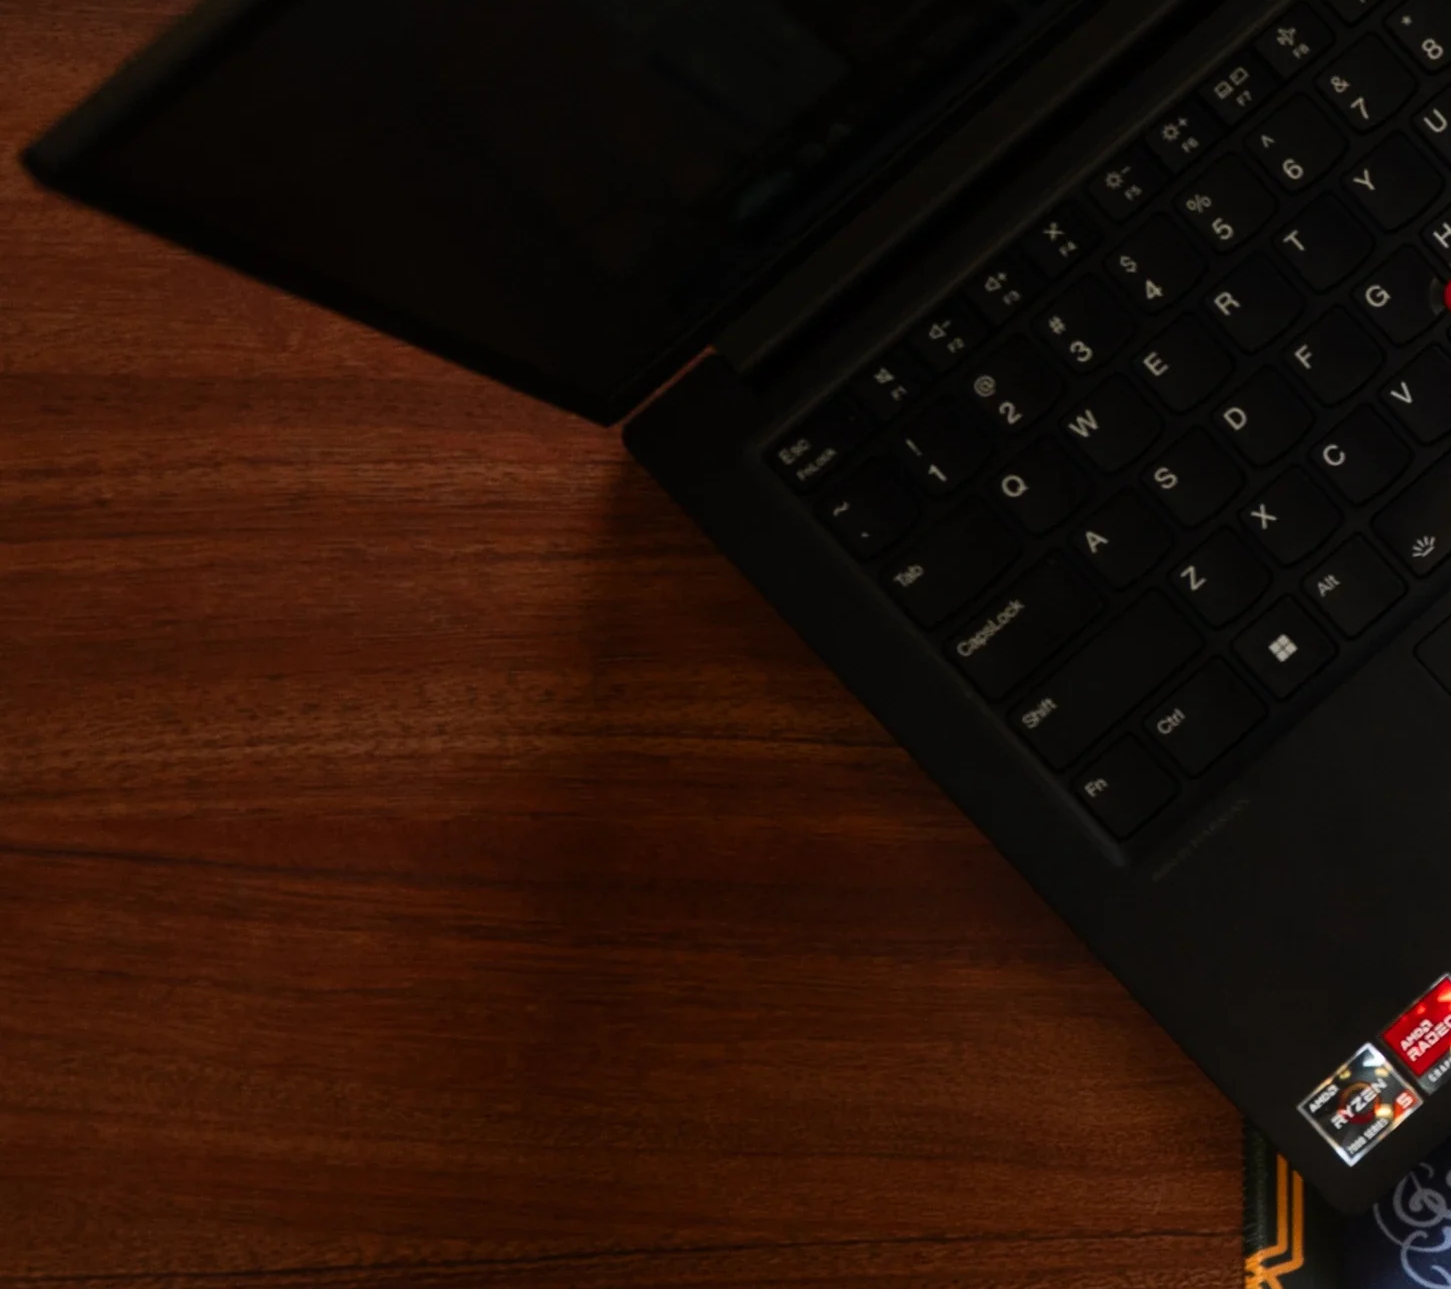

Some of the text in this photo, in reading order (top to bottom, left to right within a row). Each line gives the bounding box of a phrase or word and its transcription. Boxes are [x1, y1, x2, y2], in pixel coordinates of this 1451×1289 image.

[1420, 37, 1445, 61] 8
[1349, 96, 1370, 120] 7
[1422, 107, 1449, 134] U
[1281, 158, 1304, 181] 6
[1352, 168, 1376, 191] Y
[1210, 216, 1235, 241] 5
[1282, 229, 1306, 252] T
[1144, 279, 1163, 300] 4
[1364, 284, 1391, 309] G
[1213, 290, 1241, 317] R
[1069, 339, 1094, 363] 3
[1293, 344, 1313, 370] F
[1142, 351, 1169, 377] E
[1389, 381, 1413, 405] V
[998, 400, 1023, 425] 2
[1067, 408, 1099, 438] W
[1222, 406, 1248, 431] D
[777, 437, 810, 466] Esc
[1321, 443, 1347, 467] C
[927, 463, 948, 482] 1
[1153, 466, 1179, 490] S
[1000, 474, 1029, 499] Q
[1250, 503, 1278, 531] X
[1084, 530, 1109, 554] A
[893, 564, 924, 588] Tab
[1179, 564, 1207, 592] Z
[1316, 573, 1341, 598] Alt
[955, 599, 1025, 658] CapsLock
[1020, 697, 1058, 730] Shift
[1156, 707, 1186, 735] Ctrl
[1083, 778, 1109, 798] Fn
[1400, 1019, 1433, 1051] AMD
[1309, 1084, 1339, 1114] AMD
[1331, 1078, 1387, 1129] RYZEN
